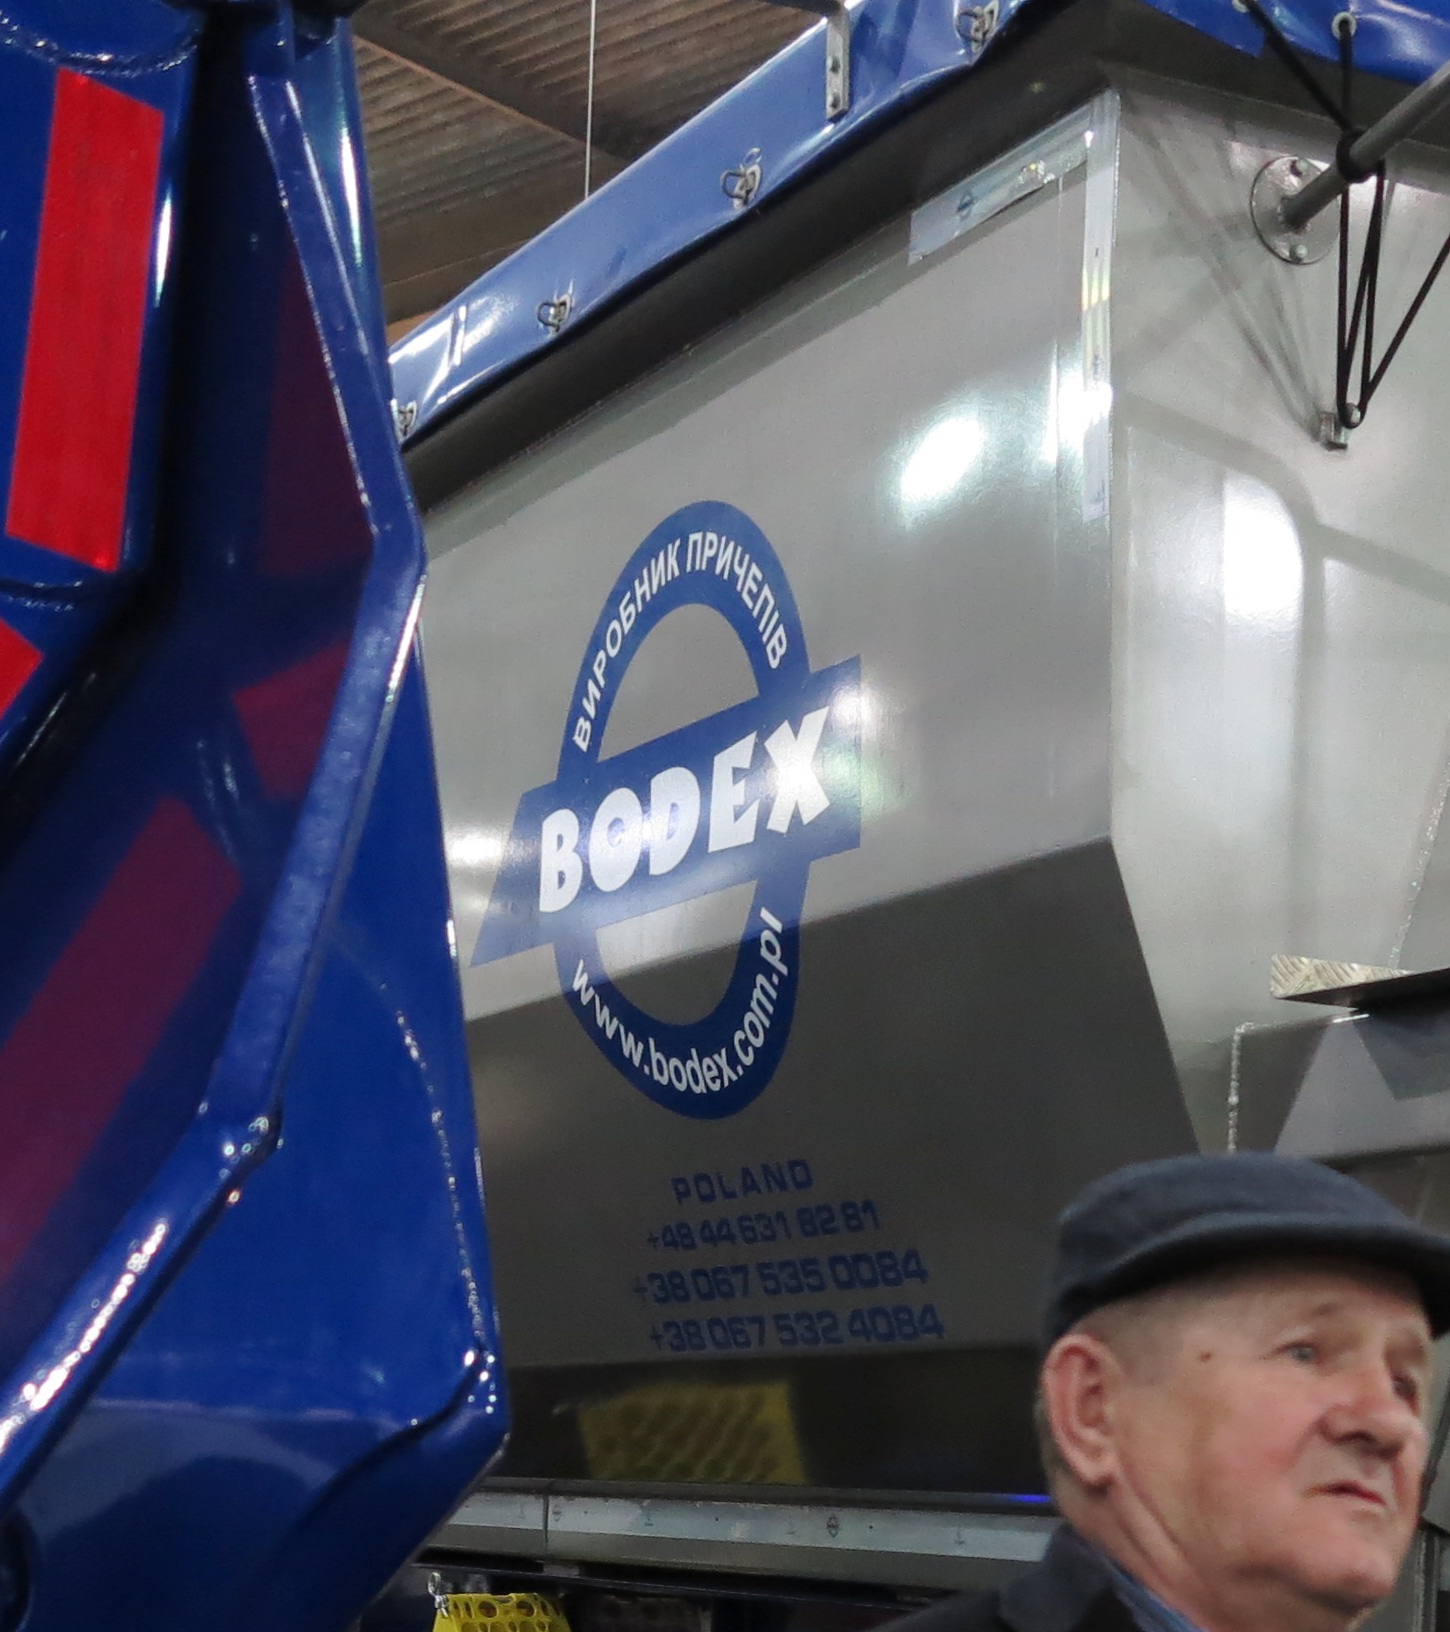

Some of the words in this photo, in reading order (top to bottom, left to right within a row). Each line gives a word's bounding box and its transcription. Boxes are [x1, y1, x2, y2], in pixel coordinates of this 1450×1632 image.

[572, 537, 682, 753] ВИРОБНИК
[685, 530, 789, 670] ПРИЧЕПІВ
[538, 704, 830, 913] BODEX
[572, 906, 789, 1094] www.bodex.com.pl
[670, 1159, 814, 1204] POLAND
[699, 1218, 737, 1247] 44
[737, 1211, 792, 1245] 631
[796, 1203, 839, 1238] 82
[756, 1257, 827, 1296] 535
[828, 1248, 929, 1290] 0084
[772, 1309, 844, 1348] 532
[847, 1303, 946, 1343] 4084
